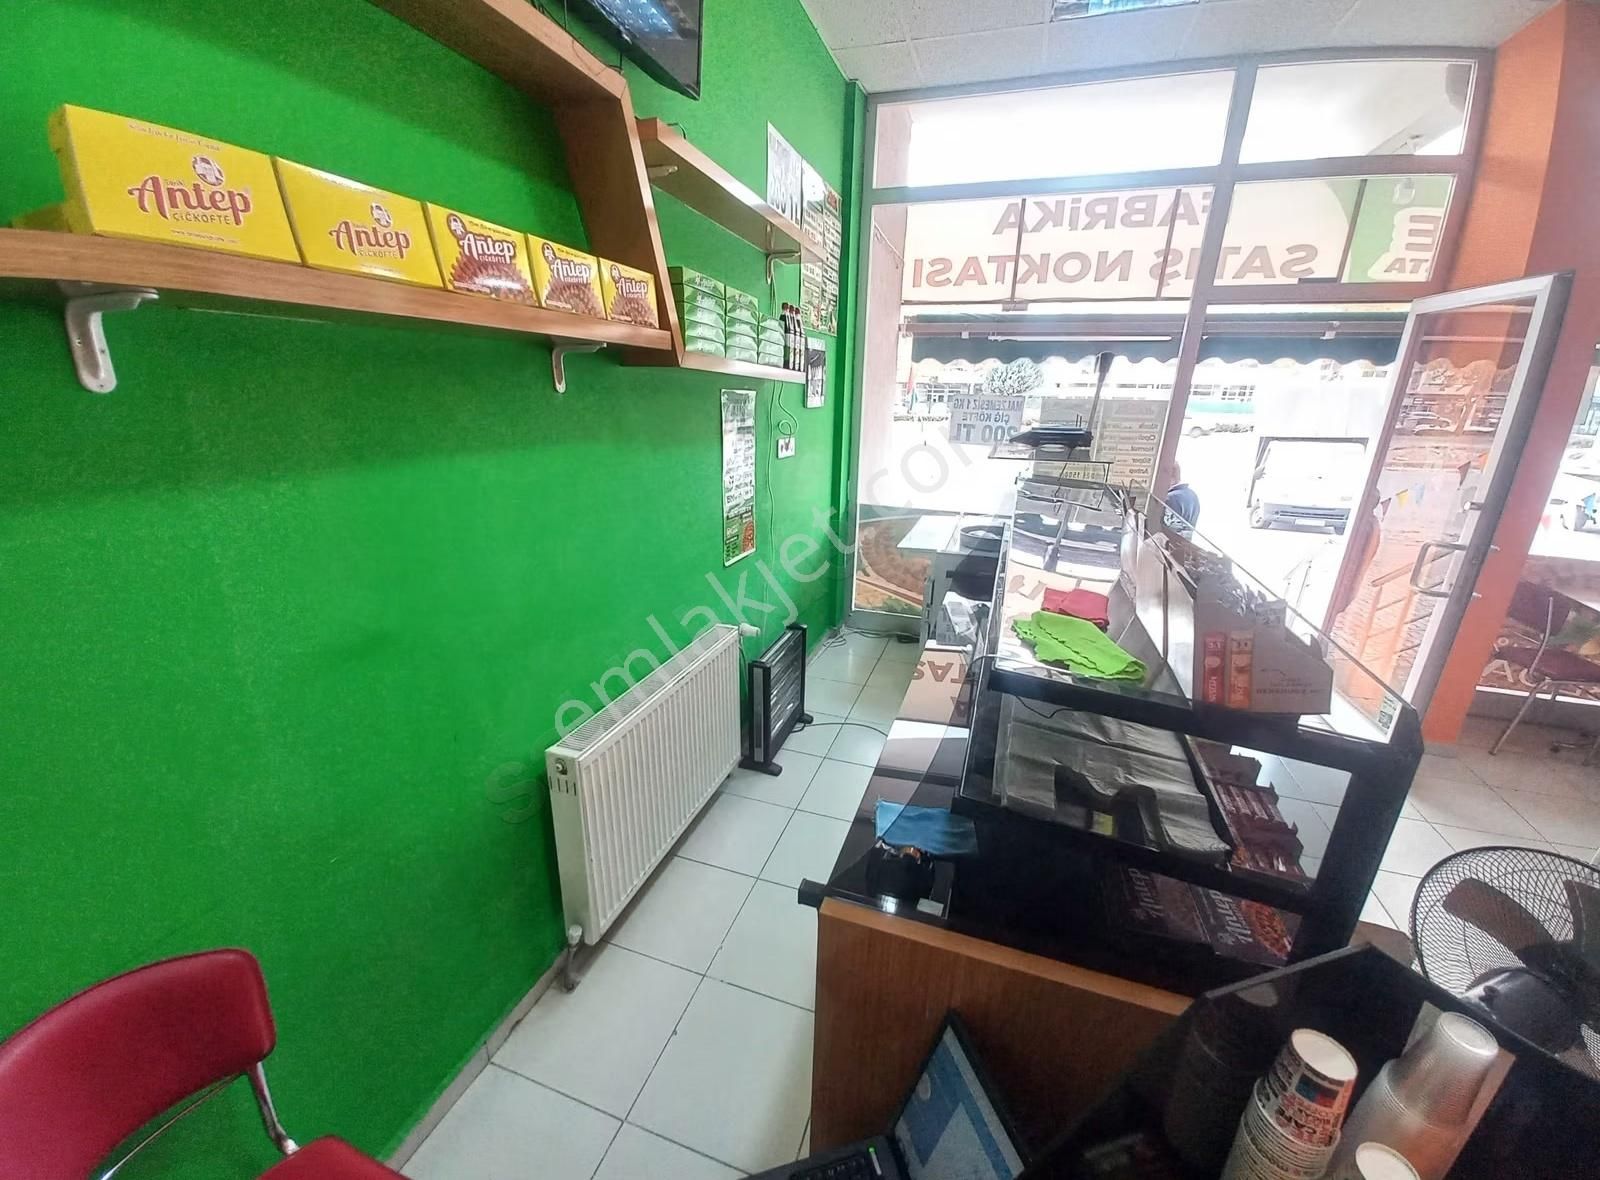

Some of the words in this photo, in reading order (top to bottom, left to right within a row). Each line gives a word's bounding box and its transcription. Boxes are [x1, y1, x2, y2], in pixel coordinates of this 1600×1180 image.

[128, 176, 251, 226] Antep
[329, 220, 411, 260] Antep
[460, 233, 515, 264] Antep
[551, 259, 590, 284] Antep
[617, 277, 648, 299] Antep
[1209, 888, 1254, 945] Antep
